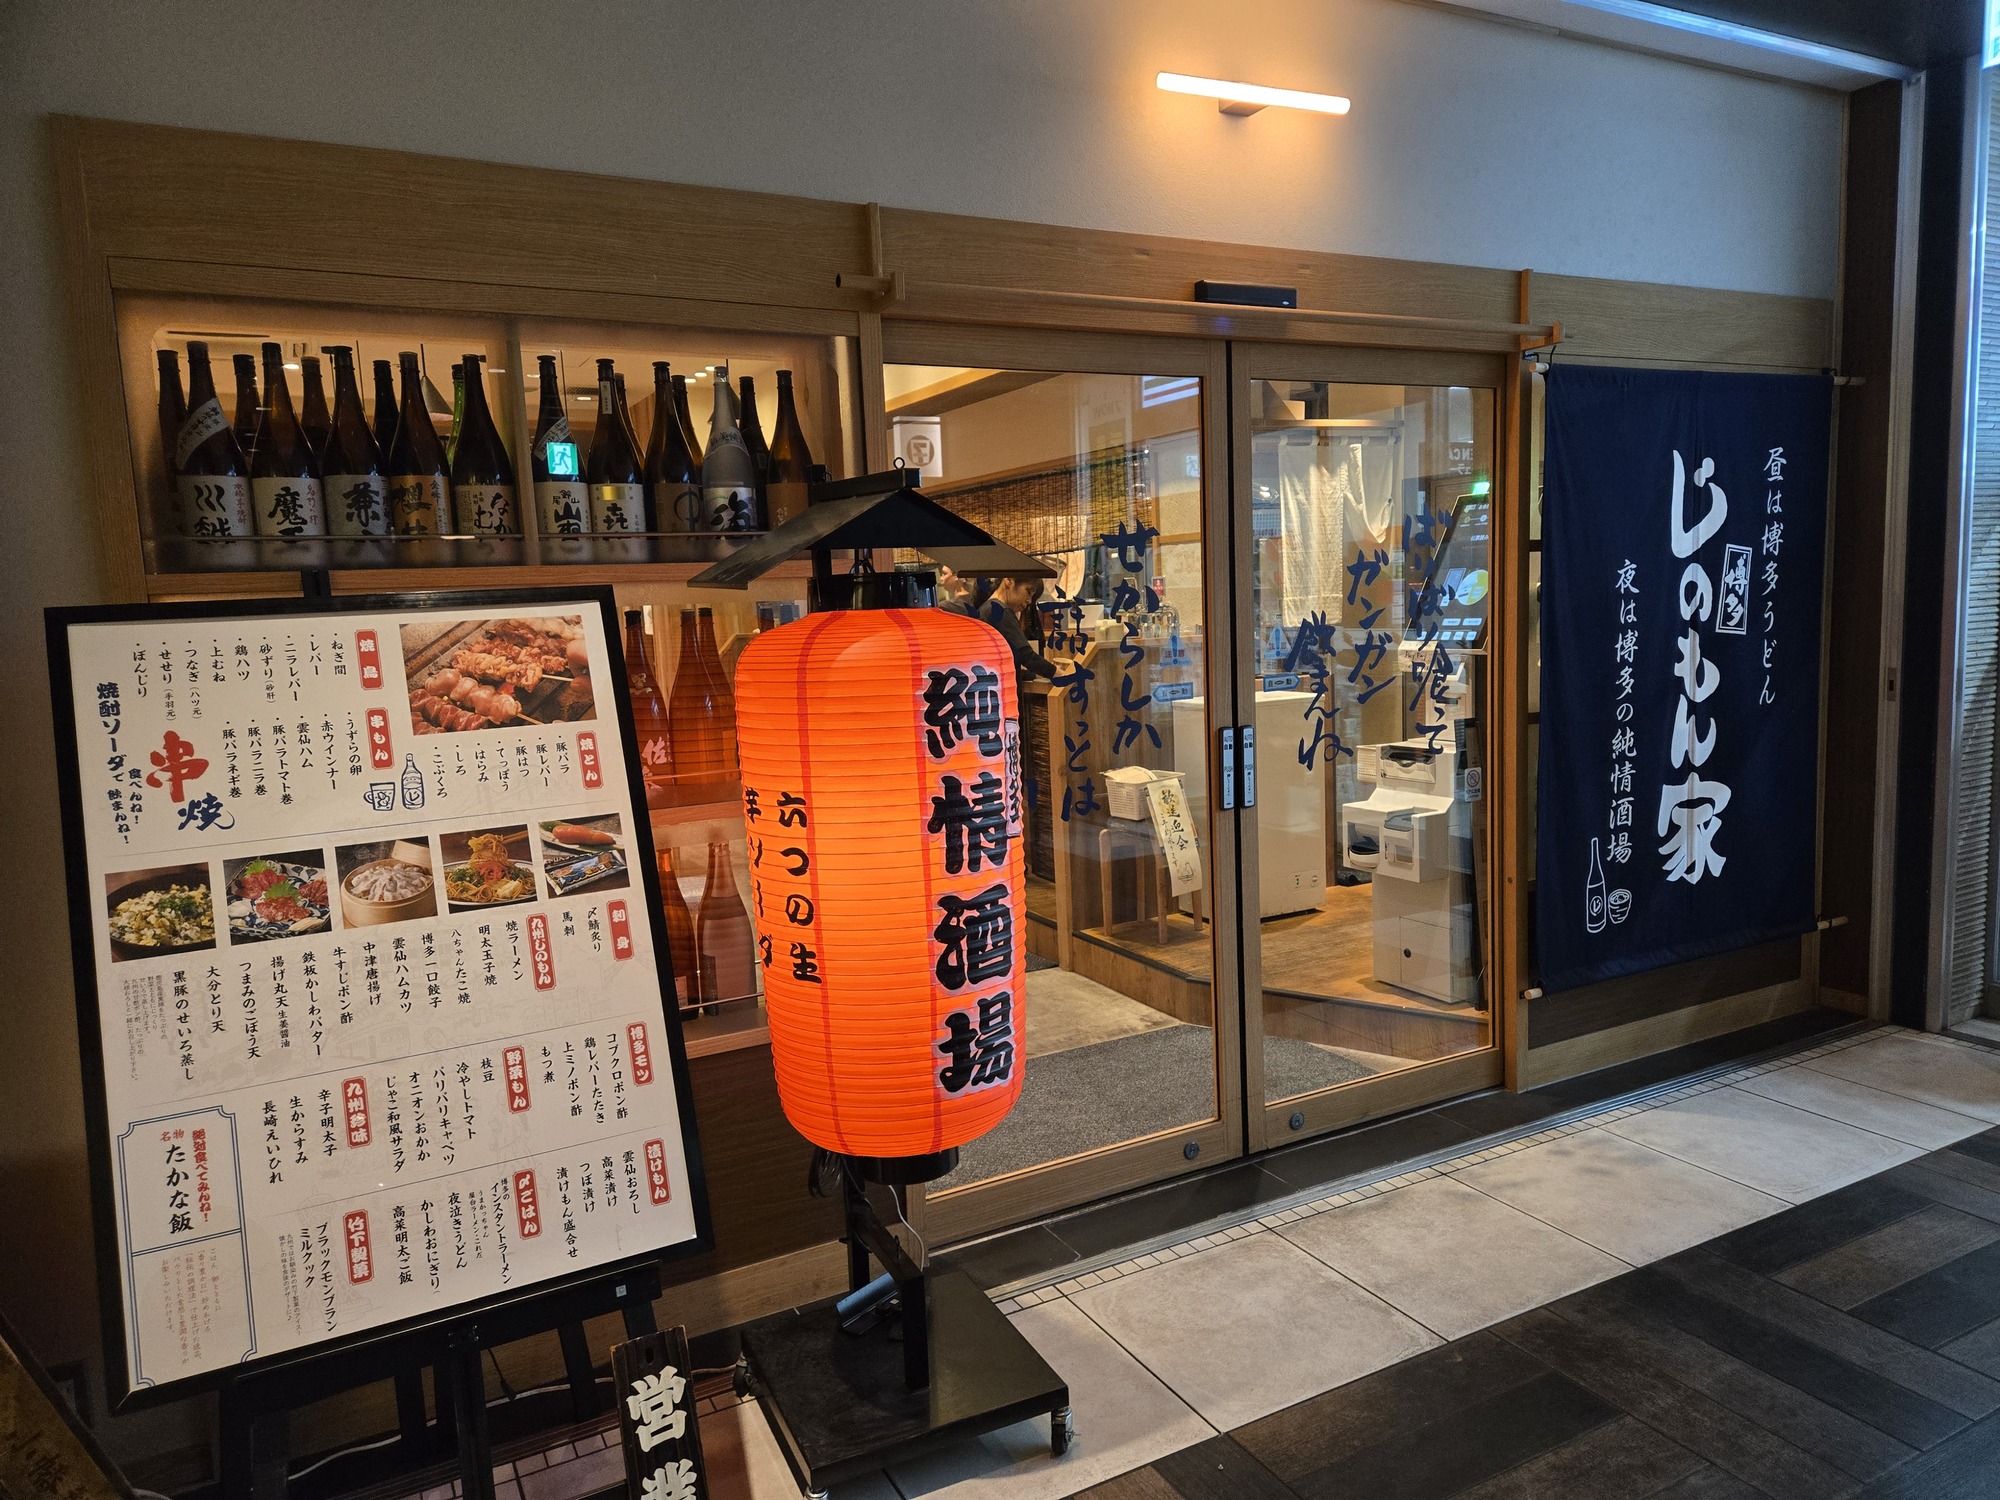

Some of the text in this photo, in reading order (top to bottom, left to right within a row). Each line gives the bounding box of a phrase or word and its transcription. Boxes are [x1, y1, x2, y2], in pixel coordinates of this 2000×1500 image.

[1723, 556, 1748, 628] 博多
[1758, 446, 1786, 706] 昼は博多うどん
[309, 641, 322, 676] レバー
[331, 640, 347, 675] ねぎ間
[359, 639, 378, 679] 焼鳥
[1100, 518, 1162, 755] せからしか
[1347, 548, 1396, 705] ガンガン
[210, 646, 226, 682] 上むね
[234, 644, 250, 681] 鶏ハツ
[284, 642, 301, 701] ニラレバー
[1657, 448, 1733, 886] じのもん家
[97, 682, 127, 782] 焼酎ソーダで
[370, 713, 389, 761] 串もん
[1038, 584, 1101, 822] 話すっとは
[1606, 558, 1641, 864] 夜は博多の純情酒場
[222, 729, 242, 798] 豚バラネギ巻
[247, 727, 267, 796] 豚バラニラ巻
[272, 725, 294, 805] 豚バラトマト巻
[296, 722, 314, 769] 雲仙ハム
[321, 720, 339, 790] 赤ウインナー
[346, 718, 363, 776] うずらの卵
[433, 754, 448, 798] こぶくろ
[455, 752, 467, 776] しろ
[474, 750, 489, 783] はらみ
[515, 746, 530, 777] 豚はつ
[535, 744, 550, 787] 豚レバー
[555, 742, 570, 774] 豚バラ
[580, 738, 598, 782] 焼とん
[1161, 789, 1188, 851] 歓送迎会
[776, 790, 823, 984] 六つの生
[923, 664, 1014, 1093] 純情酒場
[478, 924, 498, 987] 明太玉子焼
[505, 920, 525, 981] 焼ラーメン
[530, 918, 552, 985] 九州じのもん
[562, 911, 575, 937] 馬刺
[611, 908, 630, 950] 刺身
[206, 966, 226, 1033] 大分とり天
[333, 946, 354, 1025] 牛すじポン酢
[363, 942, 382, 1006] 中津唐揚げ
[392, 937, 412, 1014] 雲仙ハムカツ
[421, 933, 443, 1009] 博多一口餃子
[450, 928, 471, 1005] 八ちゃんたこ焼
[173, 970, 195, 1081] 黒豚のせいろ蒸し
[239, 961, 261, 1060] つまみのごぼう天
[302, 951, 323, 1057] 鉄板かしわバター
[480, 1057, 495, 1083] 枝豆
[506, 1051, 527, 1109] 野菜もん
[541, 1046, 556, 1084] もつ煮
[564, 1041, 583, 1117] 上ミノポン酢
[584, 1036, 605, 1124] 鶏レバーたたき
[606, 1033, 629, 1120] コブクロポン酢
[630, 1025, 650, 1082] 博多モツ
[289, 1095, 309, 1164] 生からすみ
[318, 1089, 338, 1157] 辛子明太子
[346, 1083, 368, 1143] 九州珍味
[385, 1076, 406, 1173] じゃこ和風サラダ
[409, 1071, 431, 1162] オニオンおかか
[455, 1061, 477, 1140] 冷やしトマト
[160, 1128, 185, 1142] 名物
[262, 1100, 284, 1184] 長崎えいひれ
[166, 1143, 195, 1234] たかな飯
[601, 1155, 618, 1208] 高菜漬け
[622, 1150, 641, 1214] 雲仙おろし
[648, 1144, 668, 1198] 漬けもん
[392, 1205, 413, 1284] 高菜明太ご飯
[448, 1192, 468, 1269] 夜泣きうどん
[491, 1182, 512, 1284] インスタントラーメン
[556, 1166, 579, 1259] 漬けもん盛合せ
[300, 1228, 315, 1289] ミルクック
[316, 1222, 338, 1332] ブラックモンブラン
[347, 1218, 370, 1278] 竹下製菓
